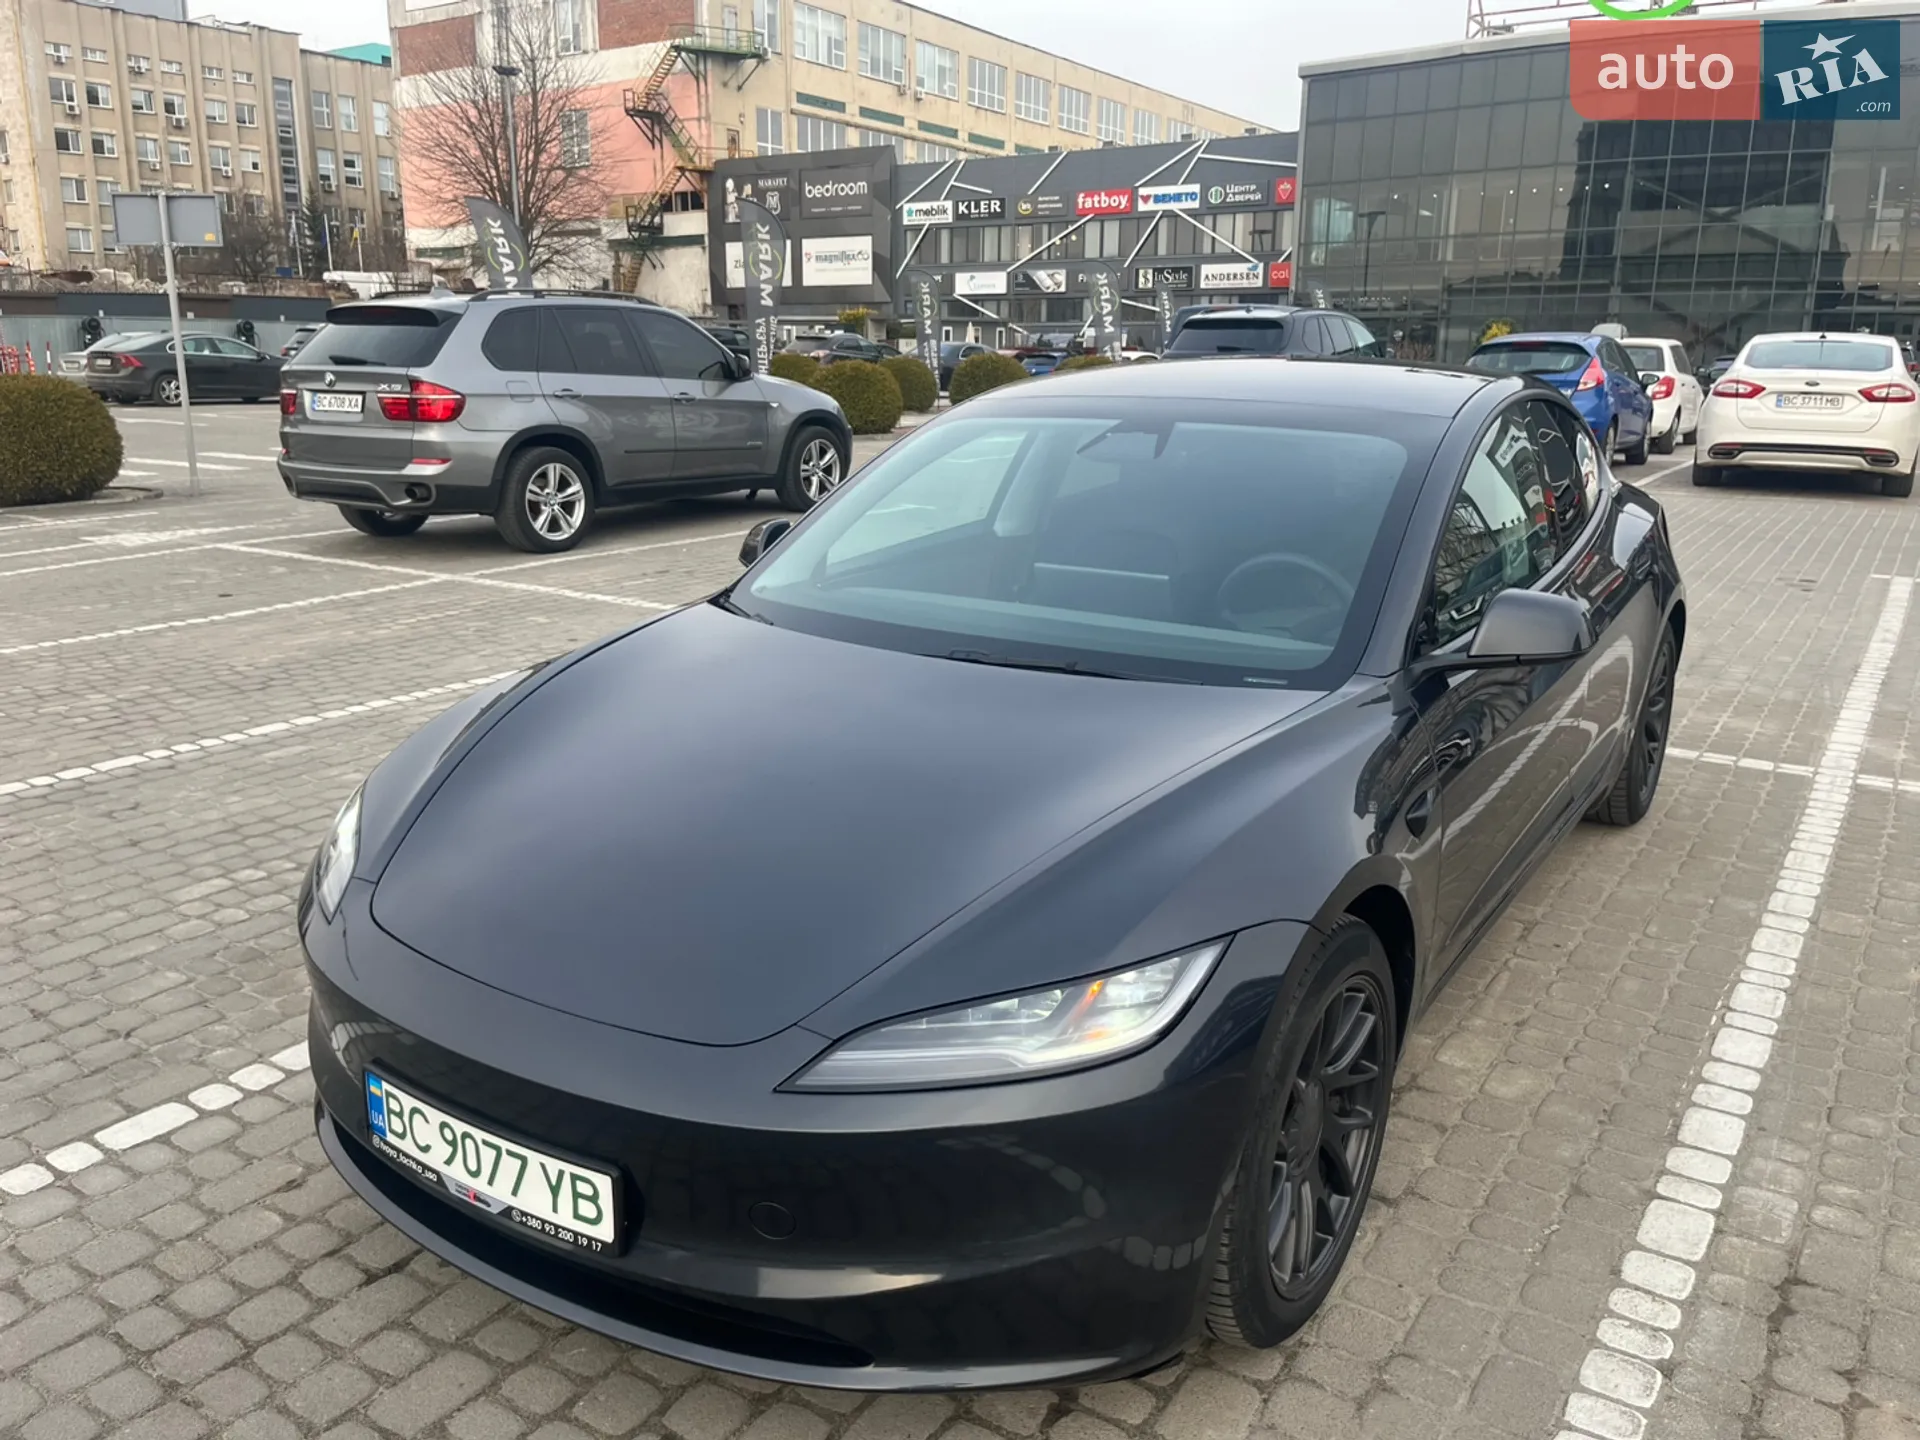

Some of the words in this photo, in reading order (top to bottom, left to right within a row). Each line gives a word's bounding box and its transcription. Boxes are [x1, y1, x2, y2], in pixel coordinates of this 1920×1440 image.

[805, 180, 868, 198] bedroom
[915, 204, 949, 217] meblik
[958, 200, 1001, 214] KLER
[1154, 268, 1188, 284] InStyle
[1204, 272, 1260, 281] ANDERSEN
[1784, 396, 1798, 405] BC
[371, 1110, 385, 1129] UA
[385, 1089, 432, 1154] BC
[439, 1120, 528, 1198] 9077
[539, 1161, 604, 1227] YB
[521, 1215, 542, 1230] +380
[544, 1222, 555, 1235] 93
[557, 1228, 574, 1242] 200
[578, 1235, 588, 1247] 19
[592, 1240, 602, 1252] 17
